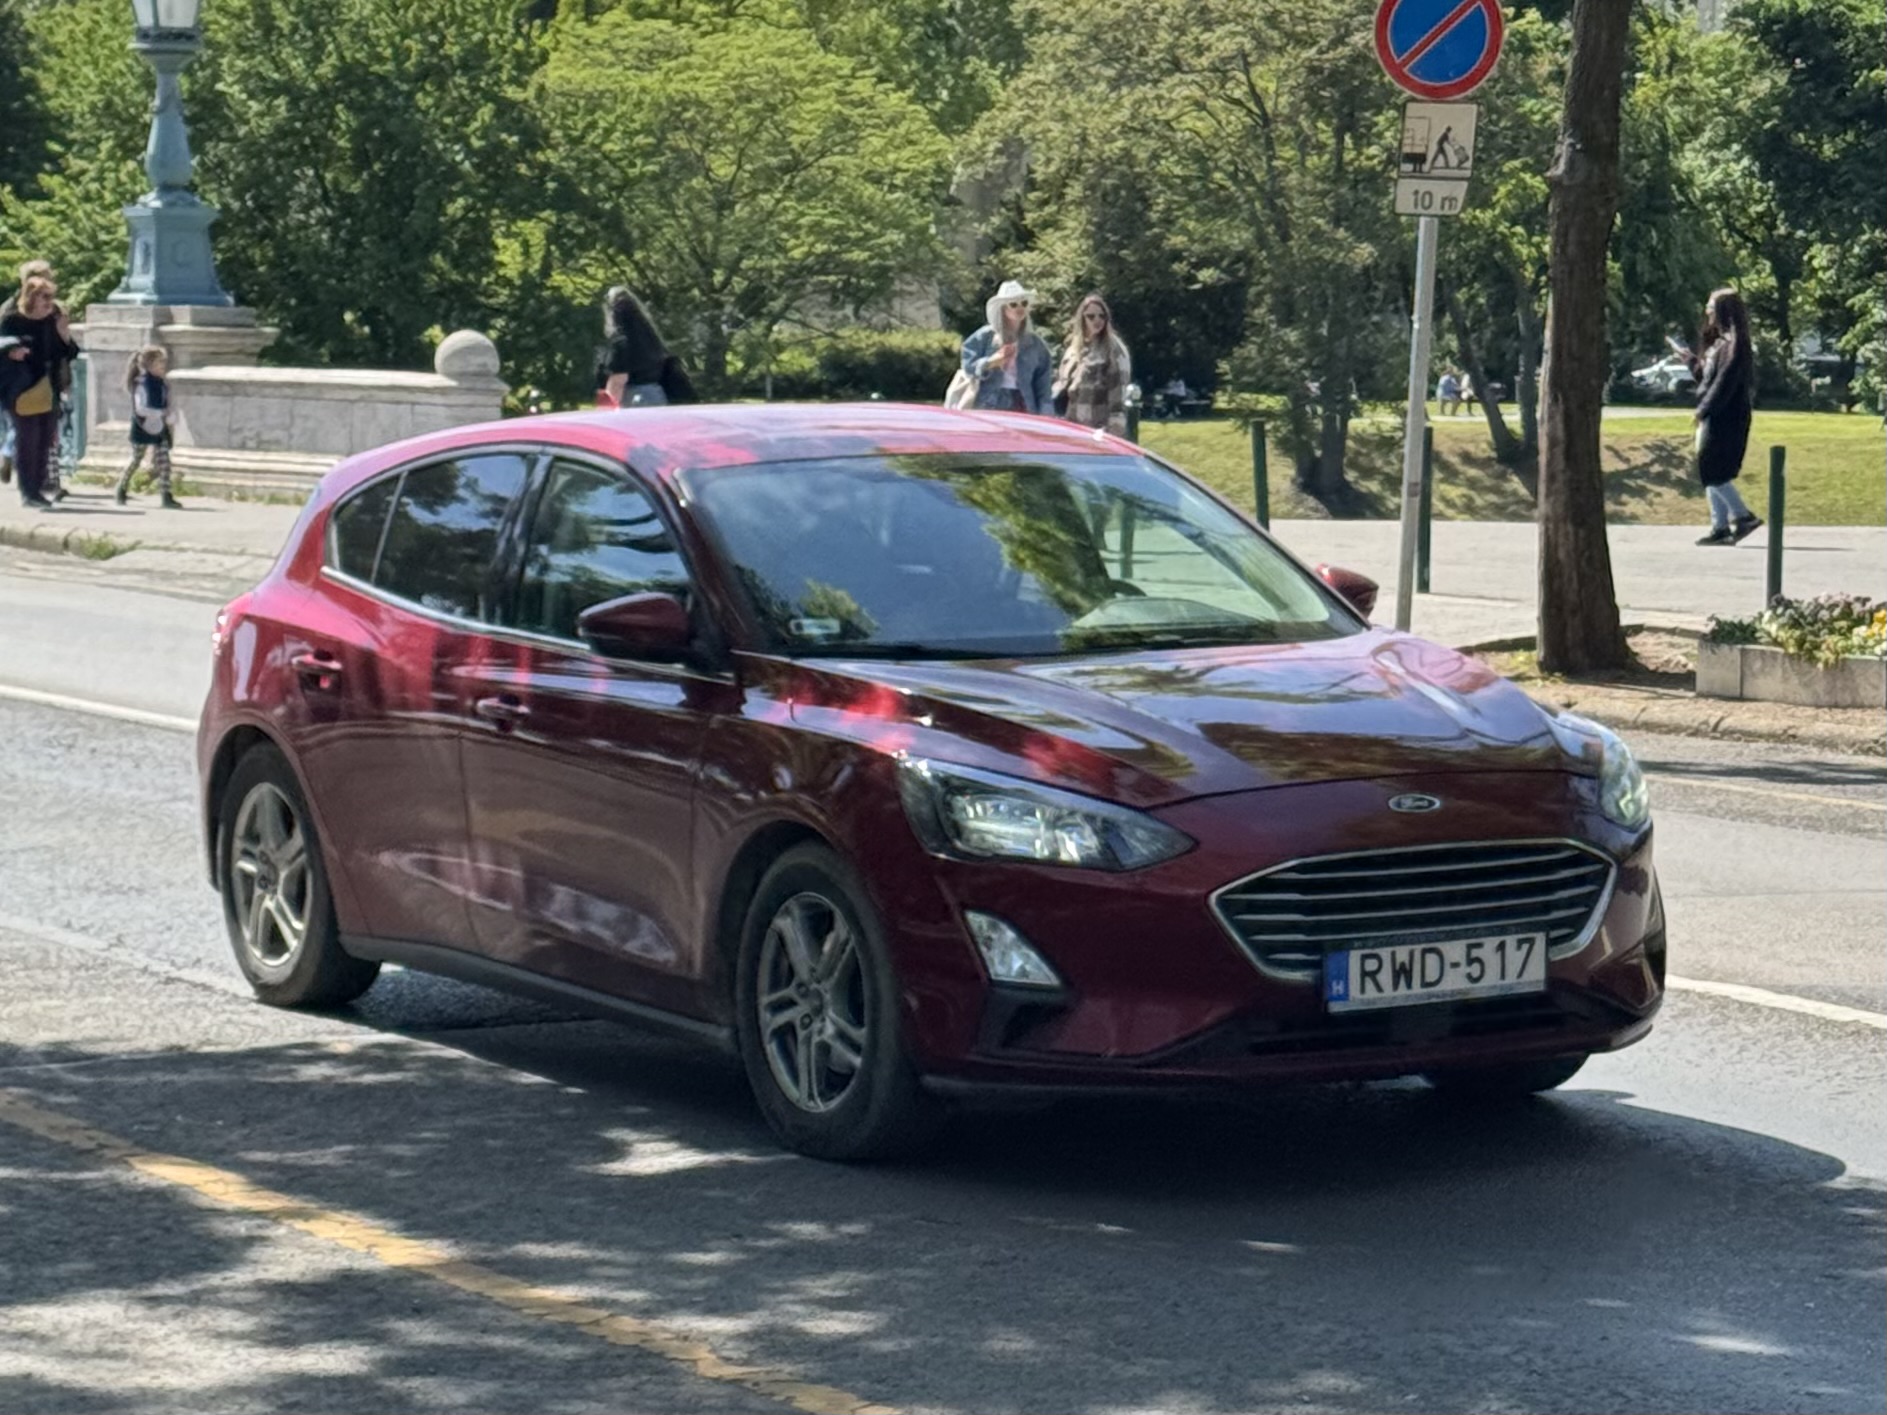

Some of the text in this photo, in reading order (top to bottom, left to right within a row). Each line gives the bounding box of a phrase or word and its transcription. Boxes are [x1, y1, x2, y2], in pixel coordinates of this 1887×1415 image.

[1412, 189, 1458, 211] 10 m
[1359, 937, 1536, 995] RWD-517
[1331, 980, 1344, 995] H
